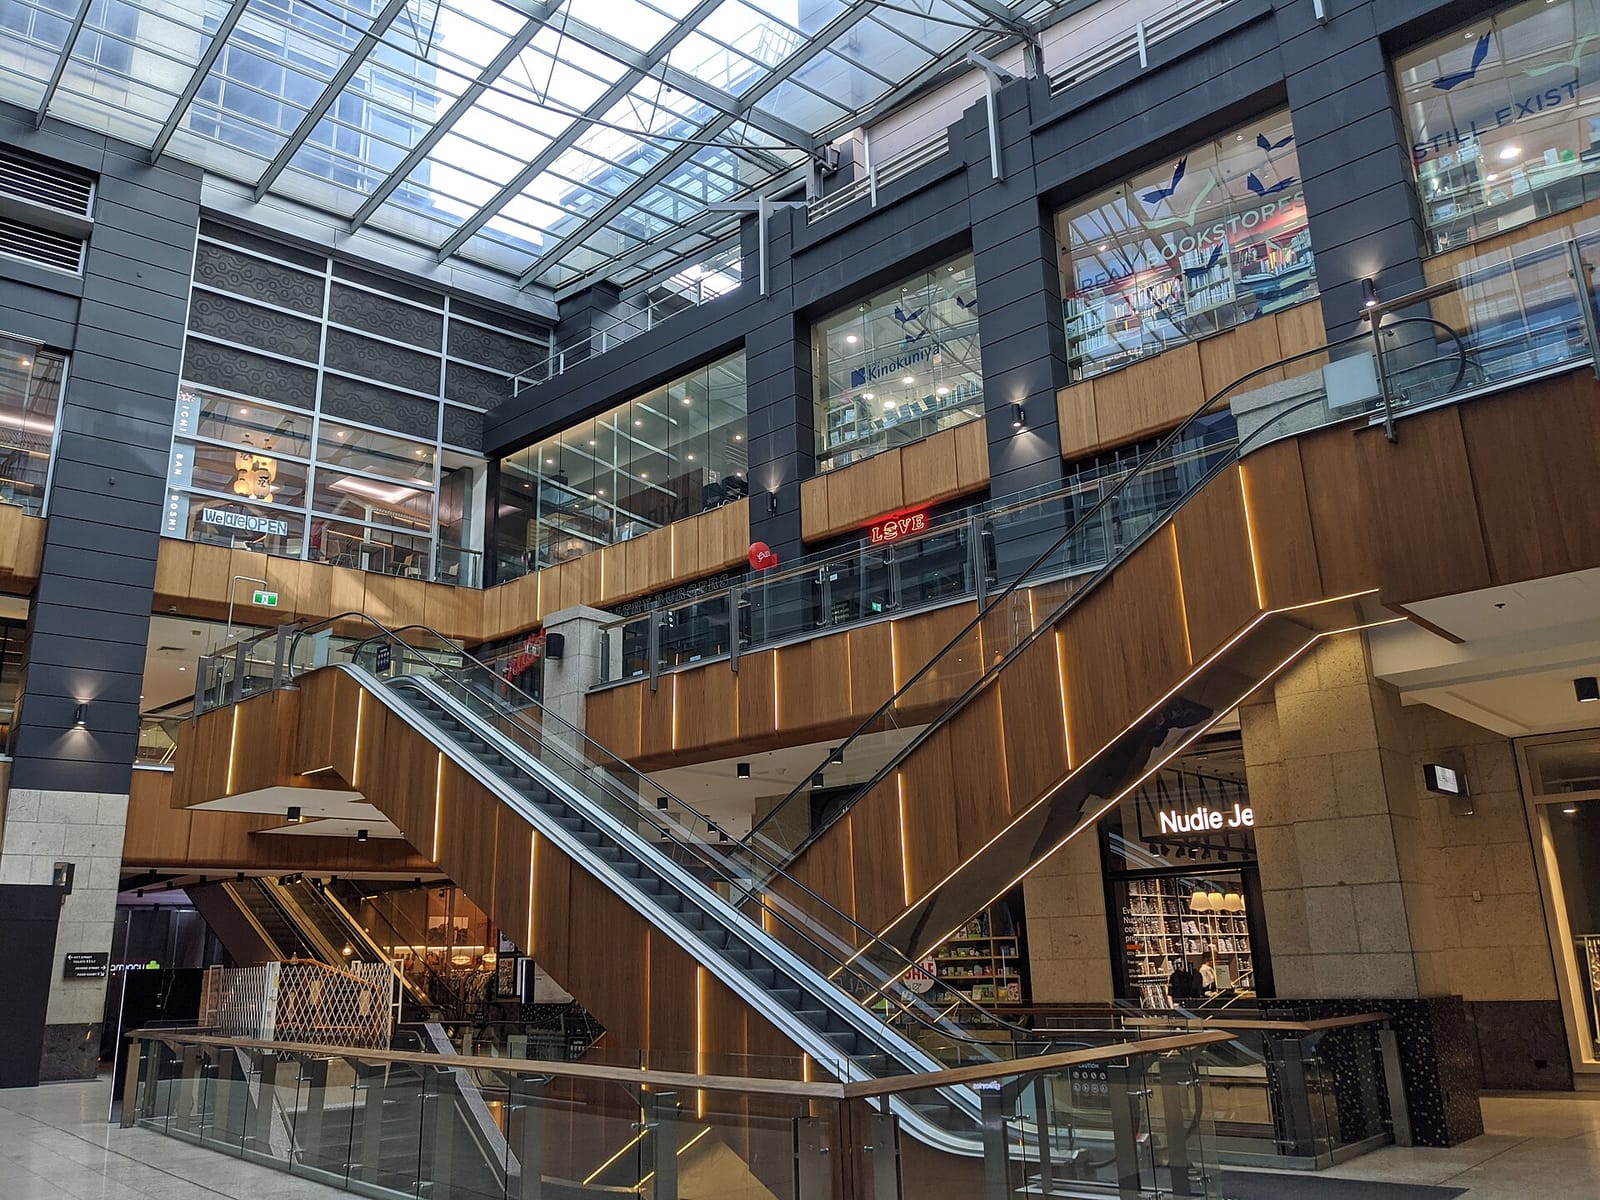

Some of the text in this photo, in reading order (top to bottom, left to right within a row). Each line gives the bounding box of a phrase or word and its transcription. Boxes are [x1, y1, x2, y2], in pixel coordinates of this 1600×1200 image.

[1413, 79, 1579, 160] STILL EXIST
[1146, 190, 1305, 269] BOOKSTORES
[868, 343, 940, 381] Kinokuniya
[168, 404, 190, 531] ICHI BAN BOSHI
[205, 509, 287, 535] We are OPEN
[655, 573, 729, 606] BURGERS
[1159, 803, 1254, 834] Nudie Je
